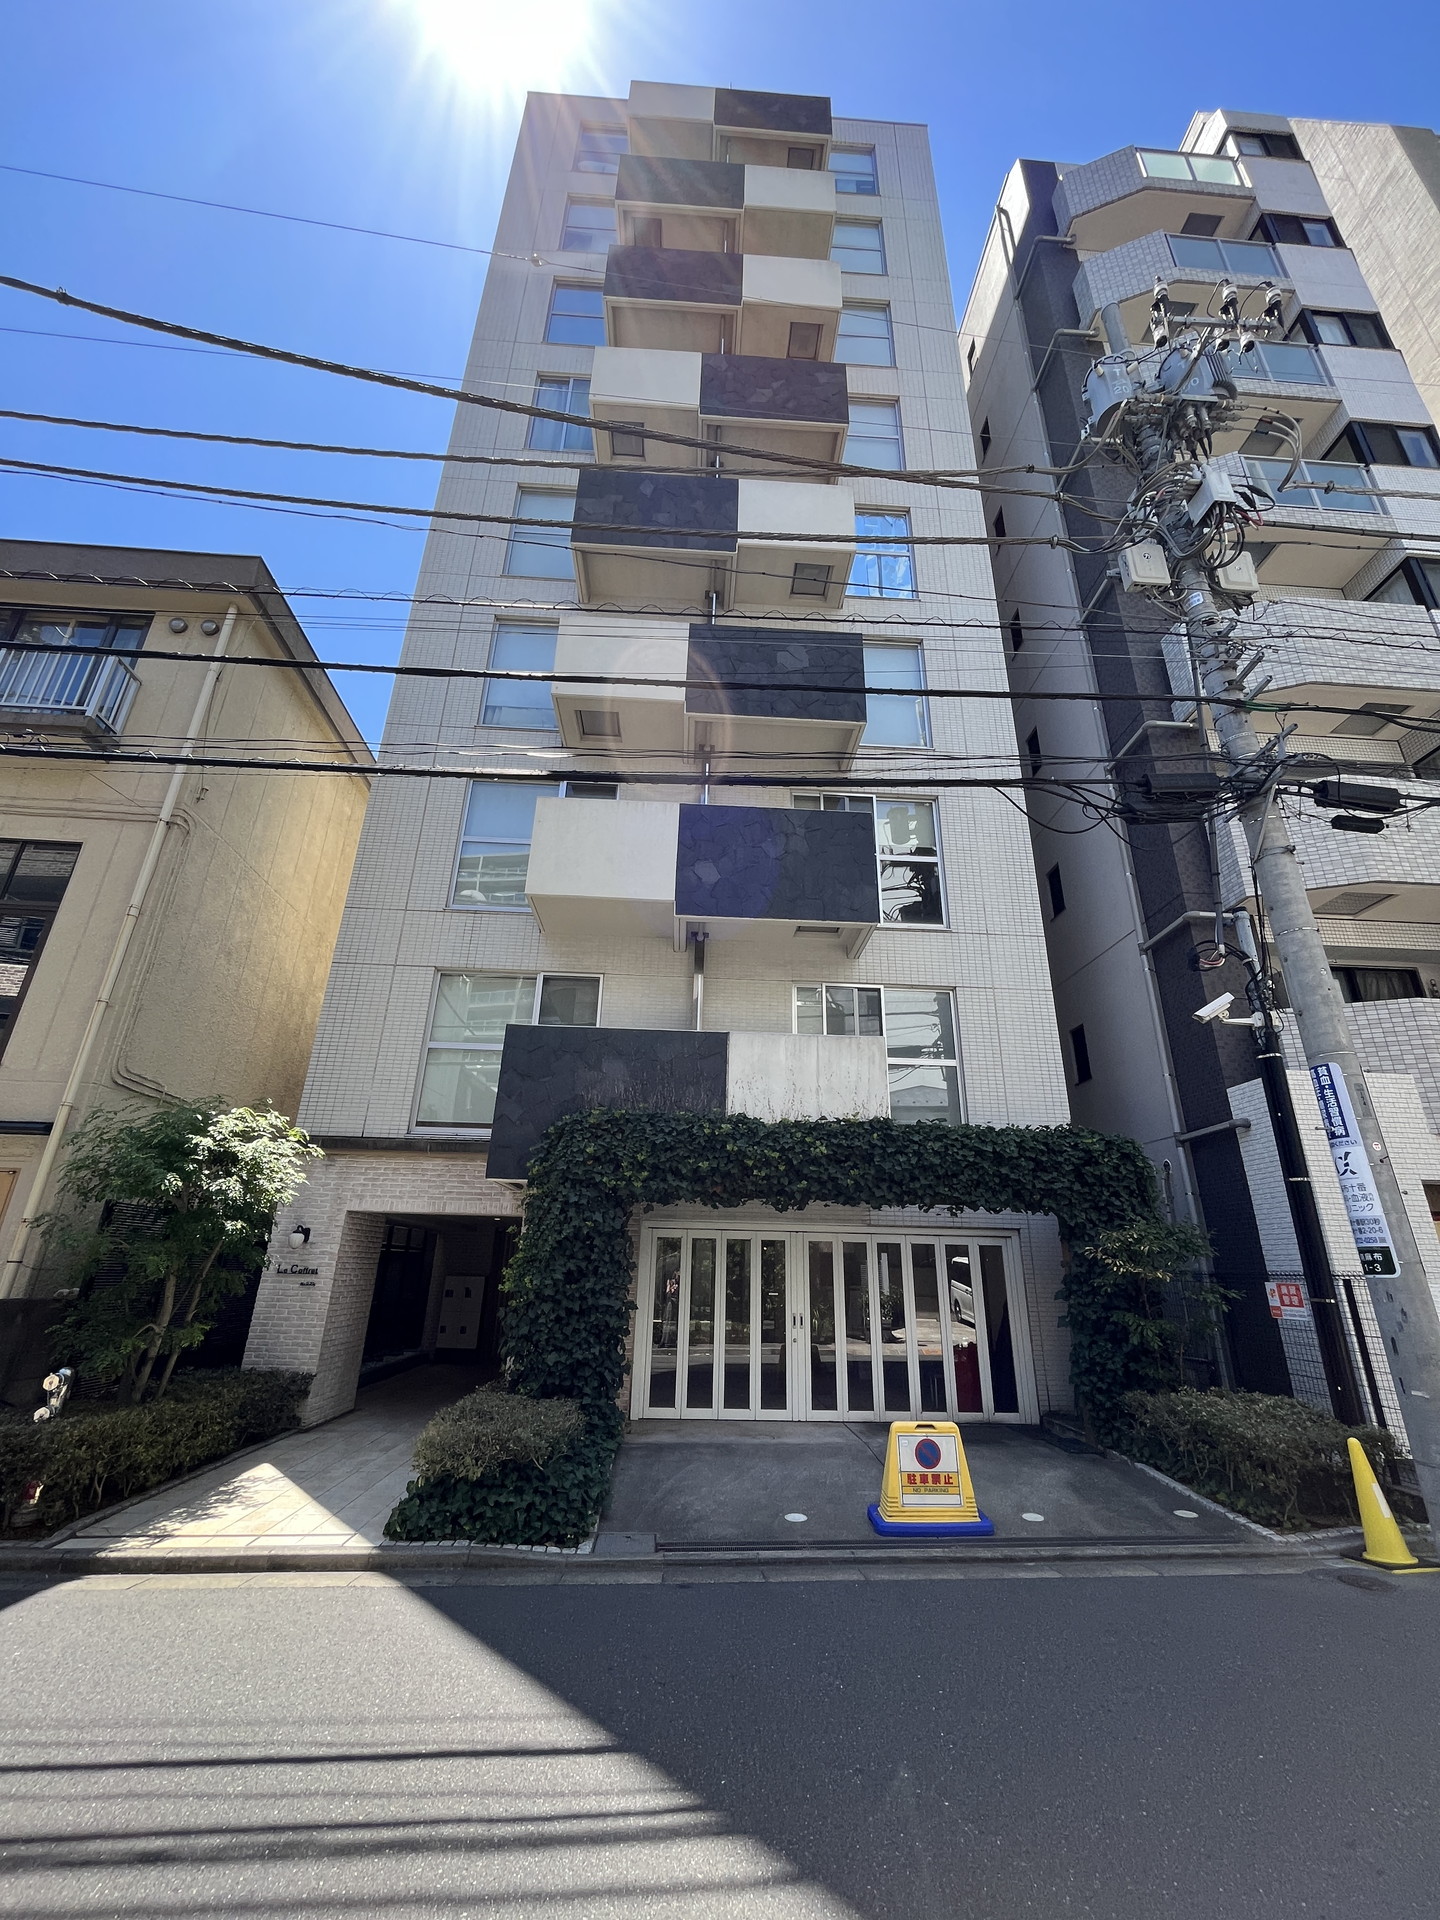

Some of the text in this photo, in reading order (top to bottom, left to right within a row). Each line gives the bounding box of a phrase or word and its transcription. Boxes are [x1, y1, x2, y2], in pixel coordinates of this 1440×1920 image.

[1113, 385, 1129, 395] 20
[1317, 1066, 1346, 1136] 貧血・生活習慣病
[906, 1473, 954, 1485] 駐車禁止
